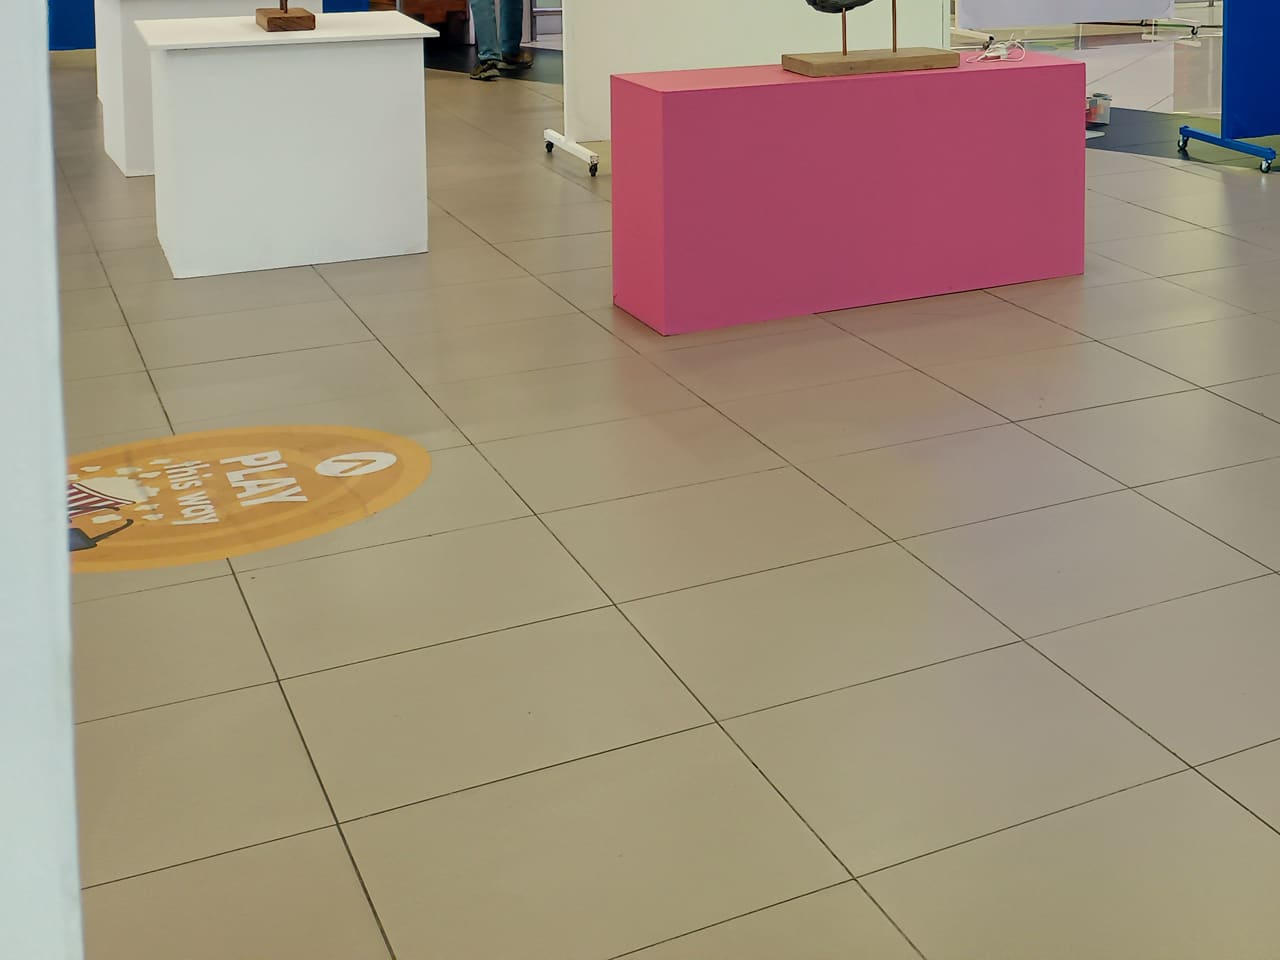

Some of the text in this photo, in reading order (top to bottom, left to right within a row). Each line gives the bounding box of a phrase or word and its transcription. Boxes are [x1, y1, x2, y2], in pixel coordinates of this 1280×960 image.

[163, 460, 221, 525] this way
[219, 449, 309, 507] PLAY
